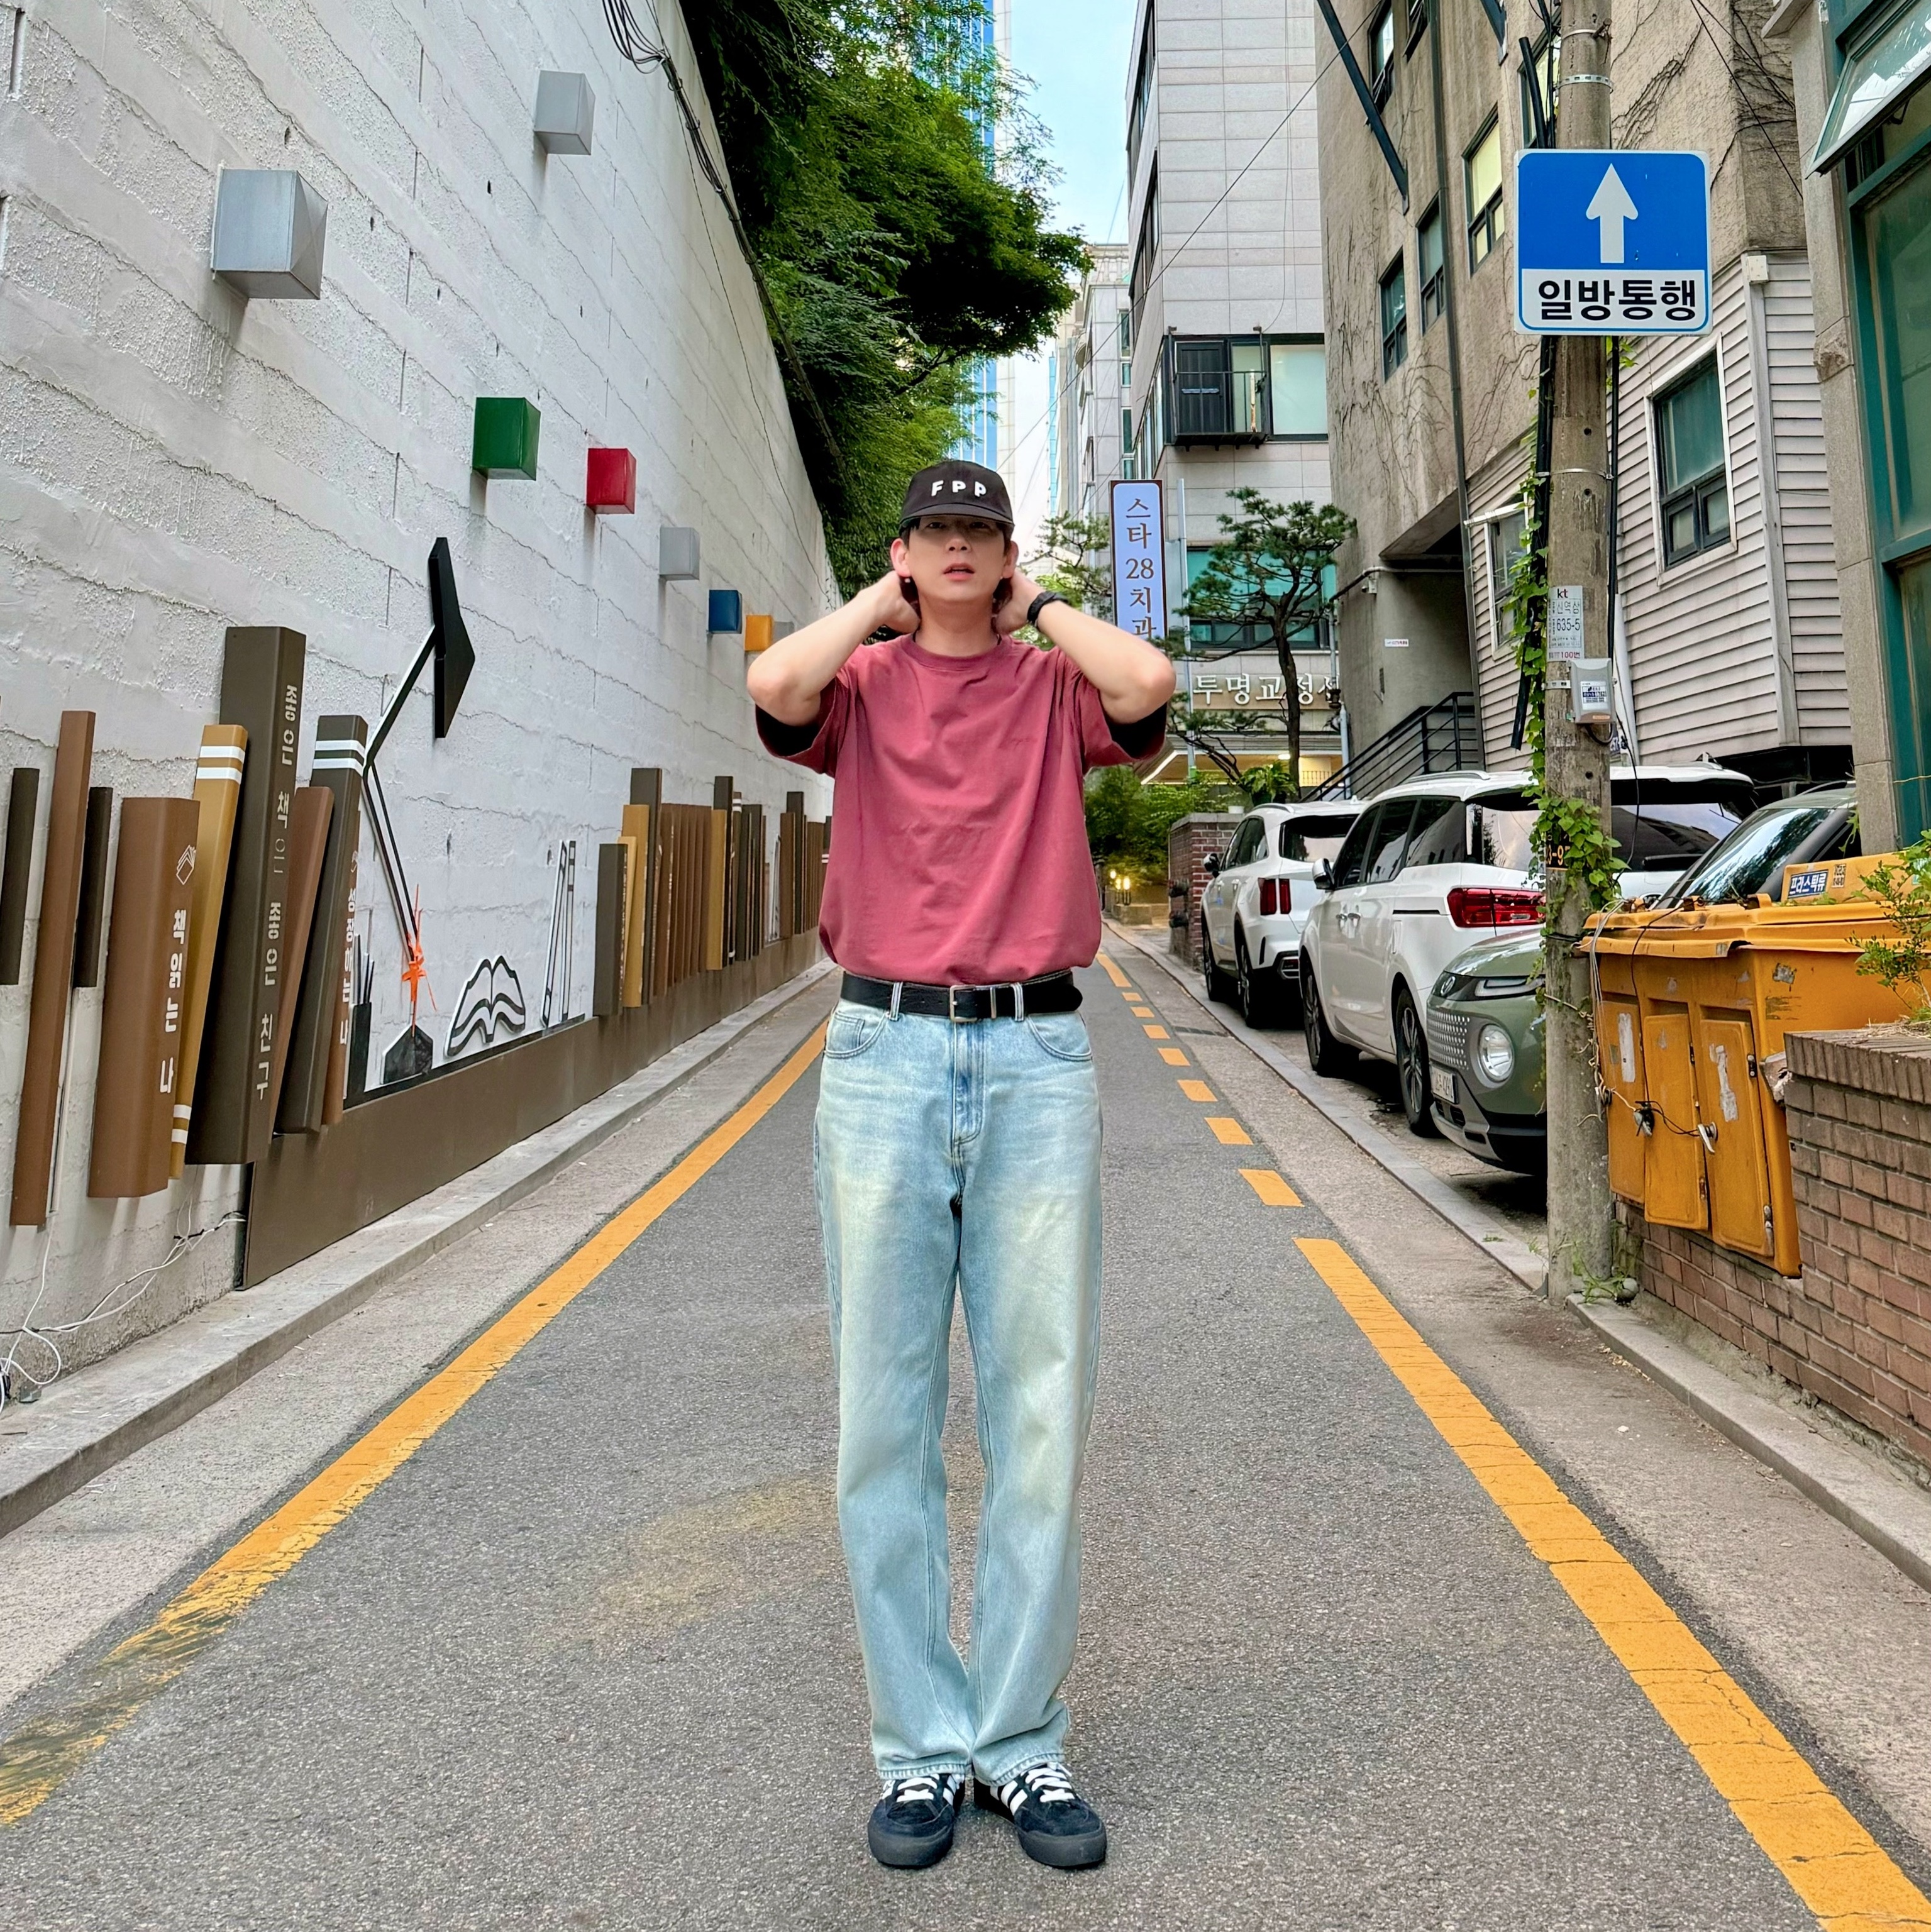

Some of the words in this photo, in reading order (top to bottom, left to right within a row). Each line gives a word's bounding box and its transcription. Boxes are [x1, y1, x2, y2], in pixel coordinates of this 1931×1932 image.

[1538, 279, 1696, 321] 일방통행
[1557, 588, 1569, 599] kt
[1556, 618, 1581, 631] 635-5
[282, 684, 298, 766] 좋은
[264, 902, 282, 986] 좋은
[159, 1057, 174, 1094] 나
[256, 1013, 273, 1101] 친구
